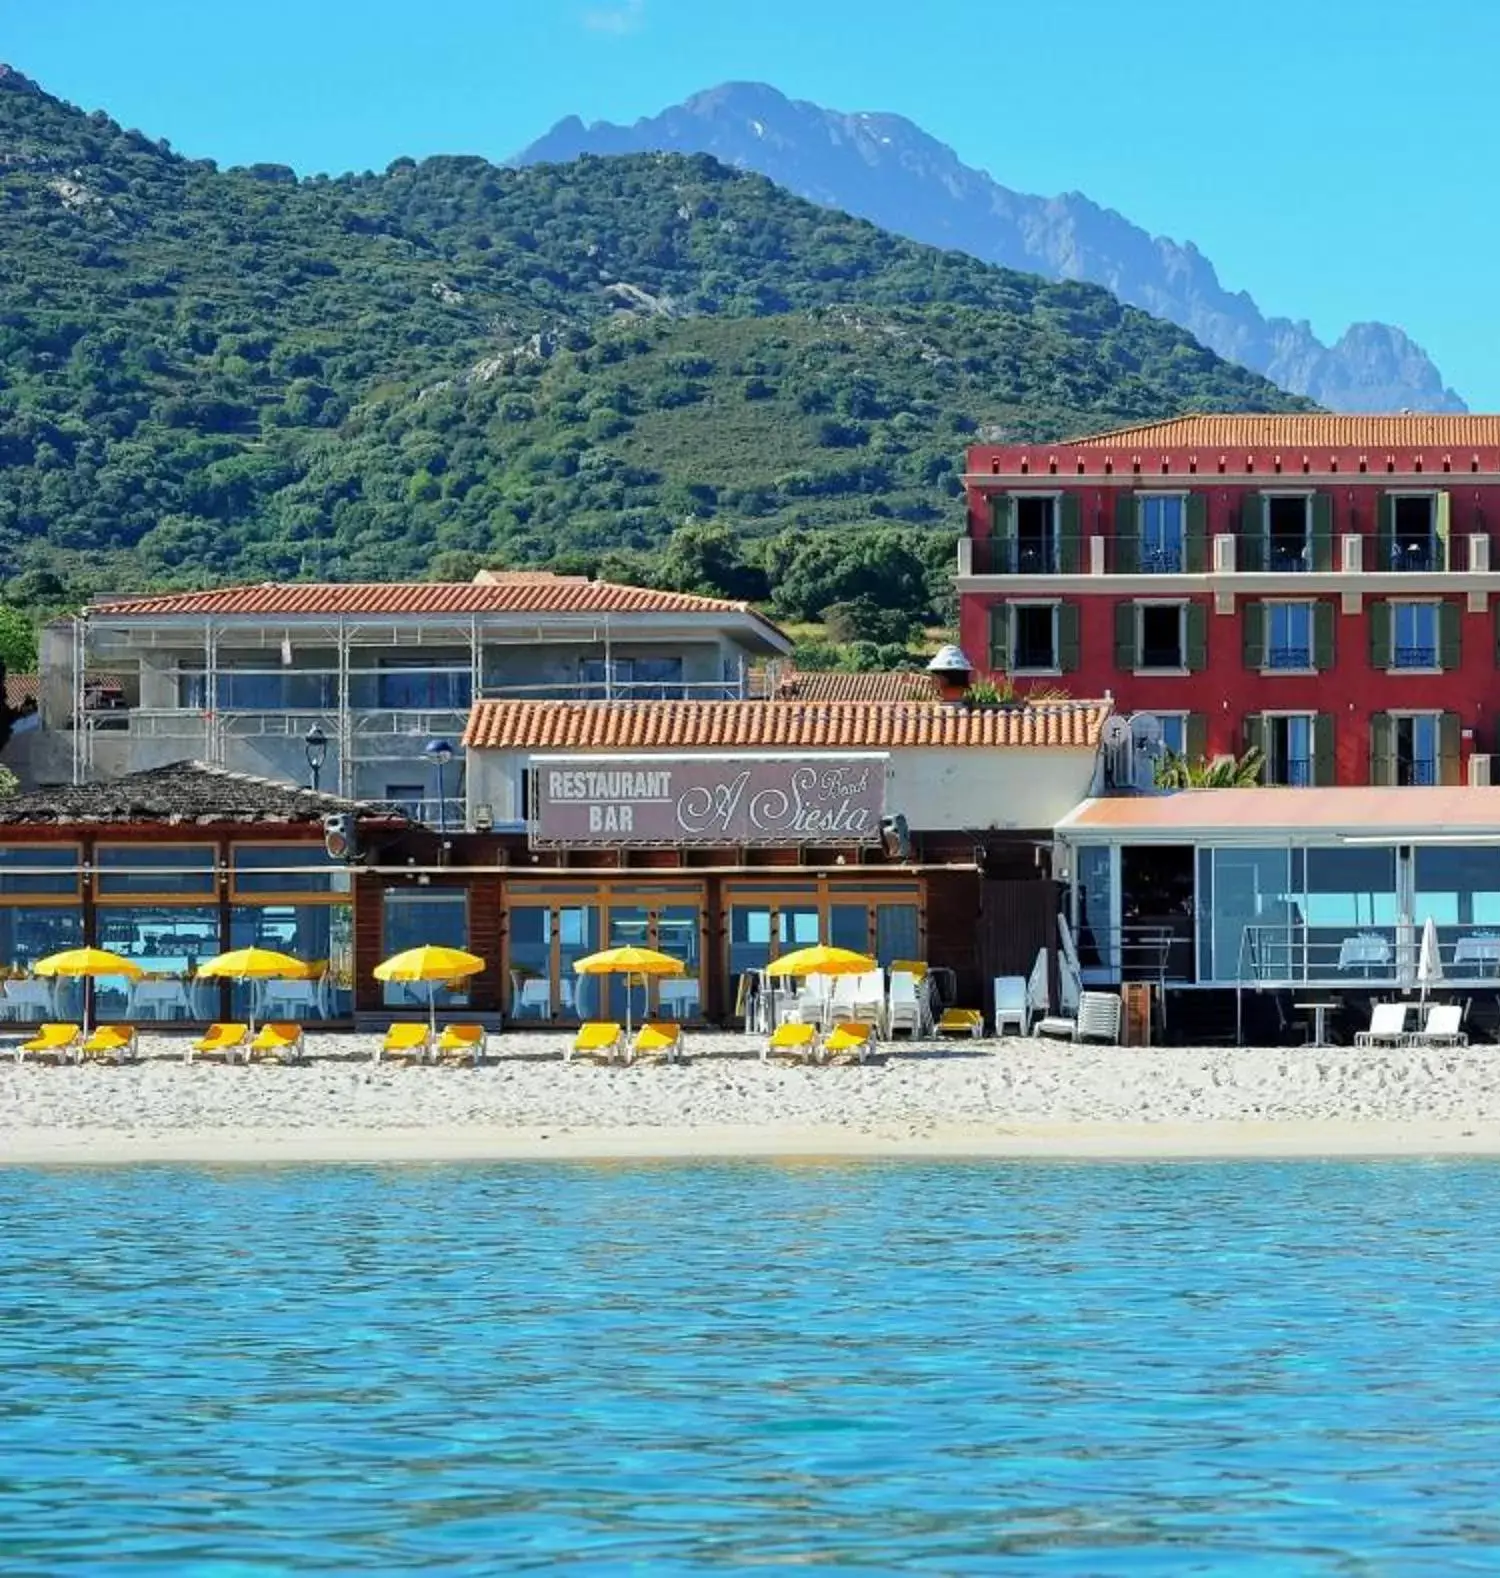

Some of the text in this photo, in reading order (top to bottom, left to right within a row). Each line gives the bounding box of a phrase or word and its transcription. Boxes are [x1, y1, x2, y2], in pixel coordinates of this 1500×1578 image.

[549, 771, 672, 798] RESTAURANT
[677, 767, 870, 832] A Siesta
[589, 805, 633, 833] BAR
